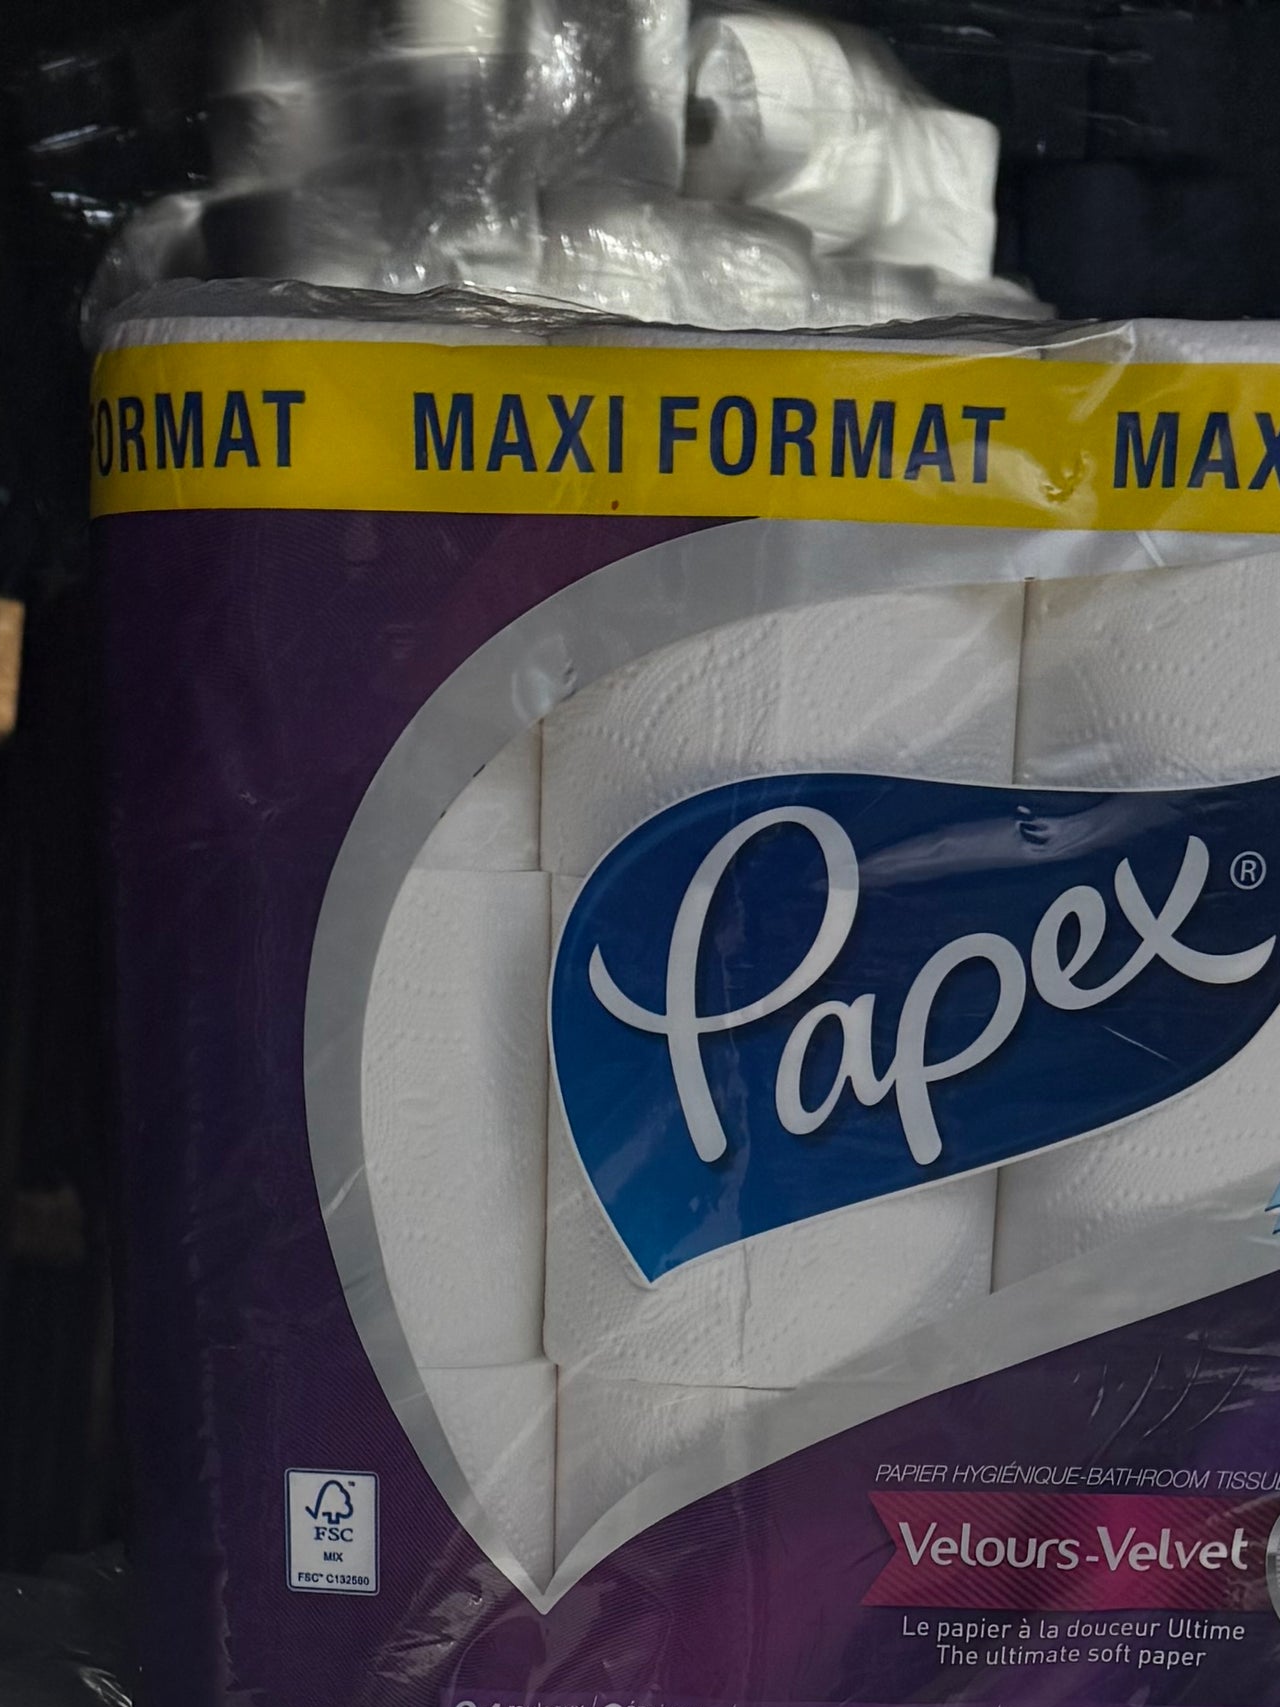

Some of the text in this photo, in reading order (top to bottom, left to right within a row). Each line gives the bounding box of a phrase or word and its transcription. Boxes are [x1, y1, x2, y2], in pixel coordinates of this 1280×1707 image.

[413, 391, 624, 474] MAXI
[658, 395, 1007, 485] FORMAT
[587, 804, 1278, 1166] Papex
[875, 1463, 951, 1484] PAPIER
[951, 1461, 1210, 1491] HYGIÉNIQUE-BATHROOM
[313, 1525, 354, 1543] FSC
[897, 1519, 1250, 1573] Velours-Velvet
[323, 1551, 344, 1562] MIX
[902, 1616, 1246, 1646] Le papier à la douceur Ultime
[937, 1643, 1207, 1672] The ultimate soft paper
